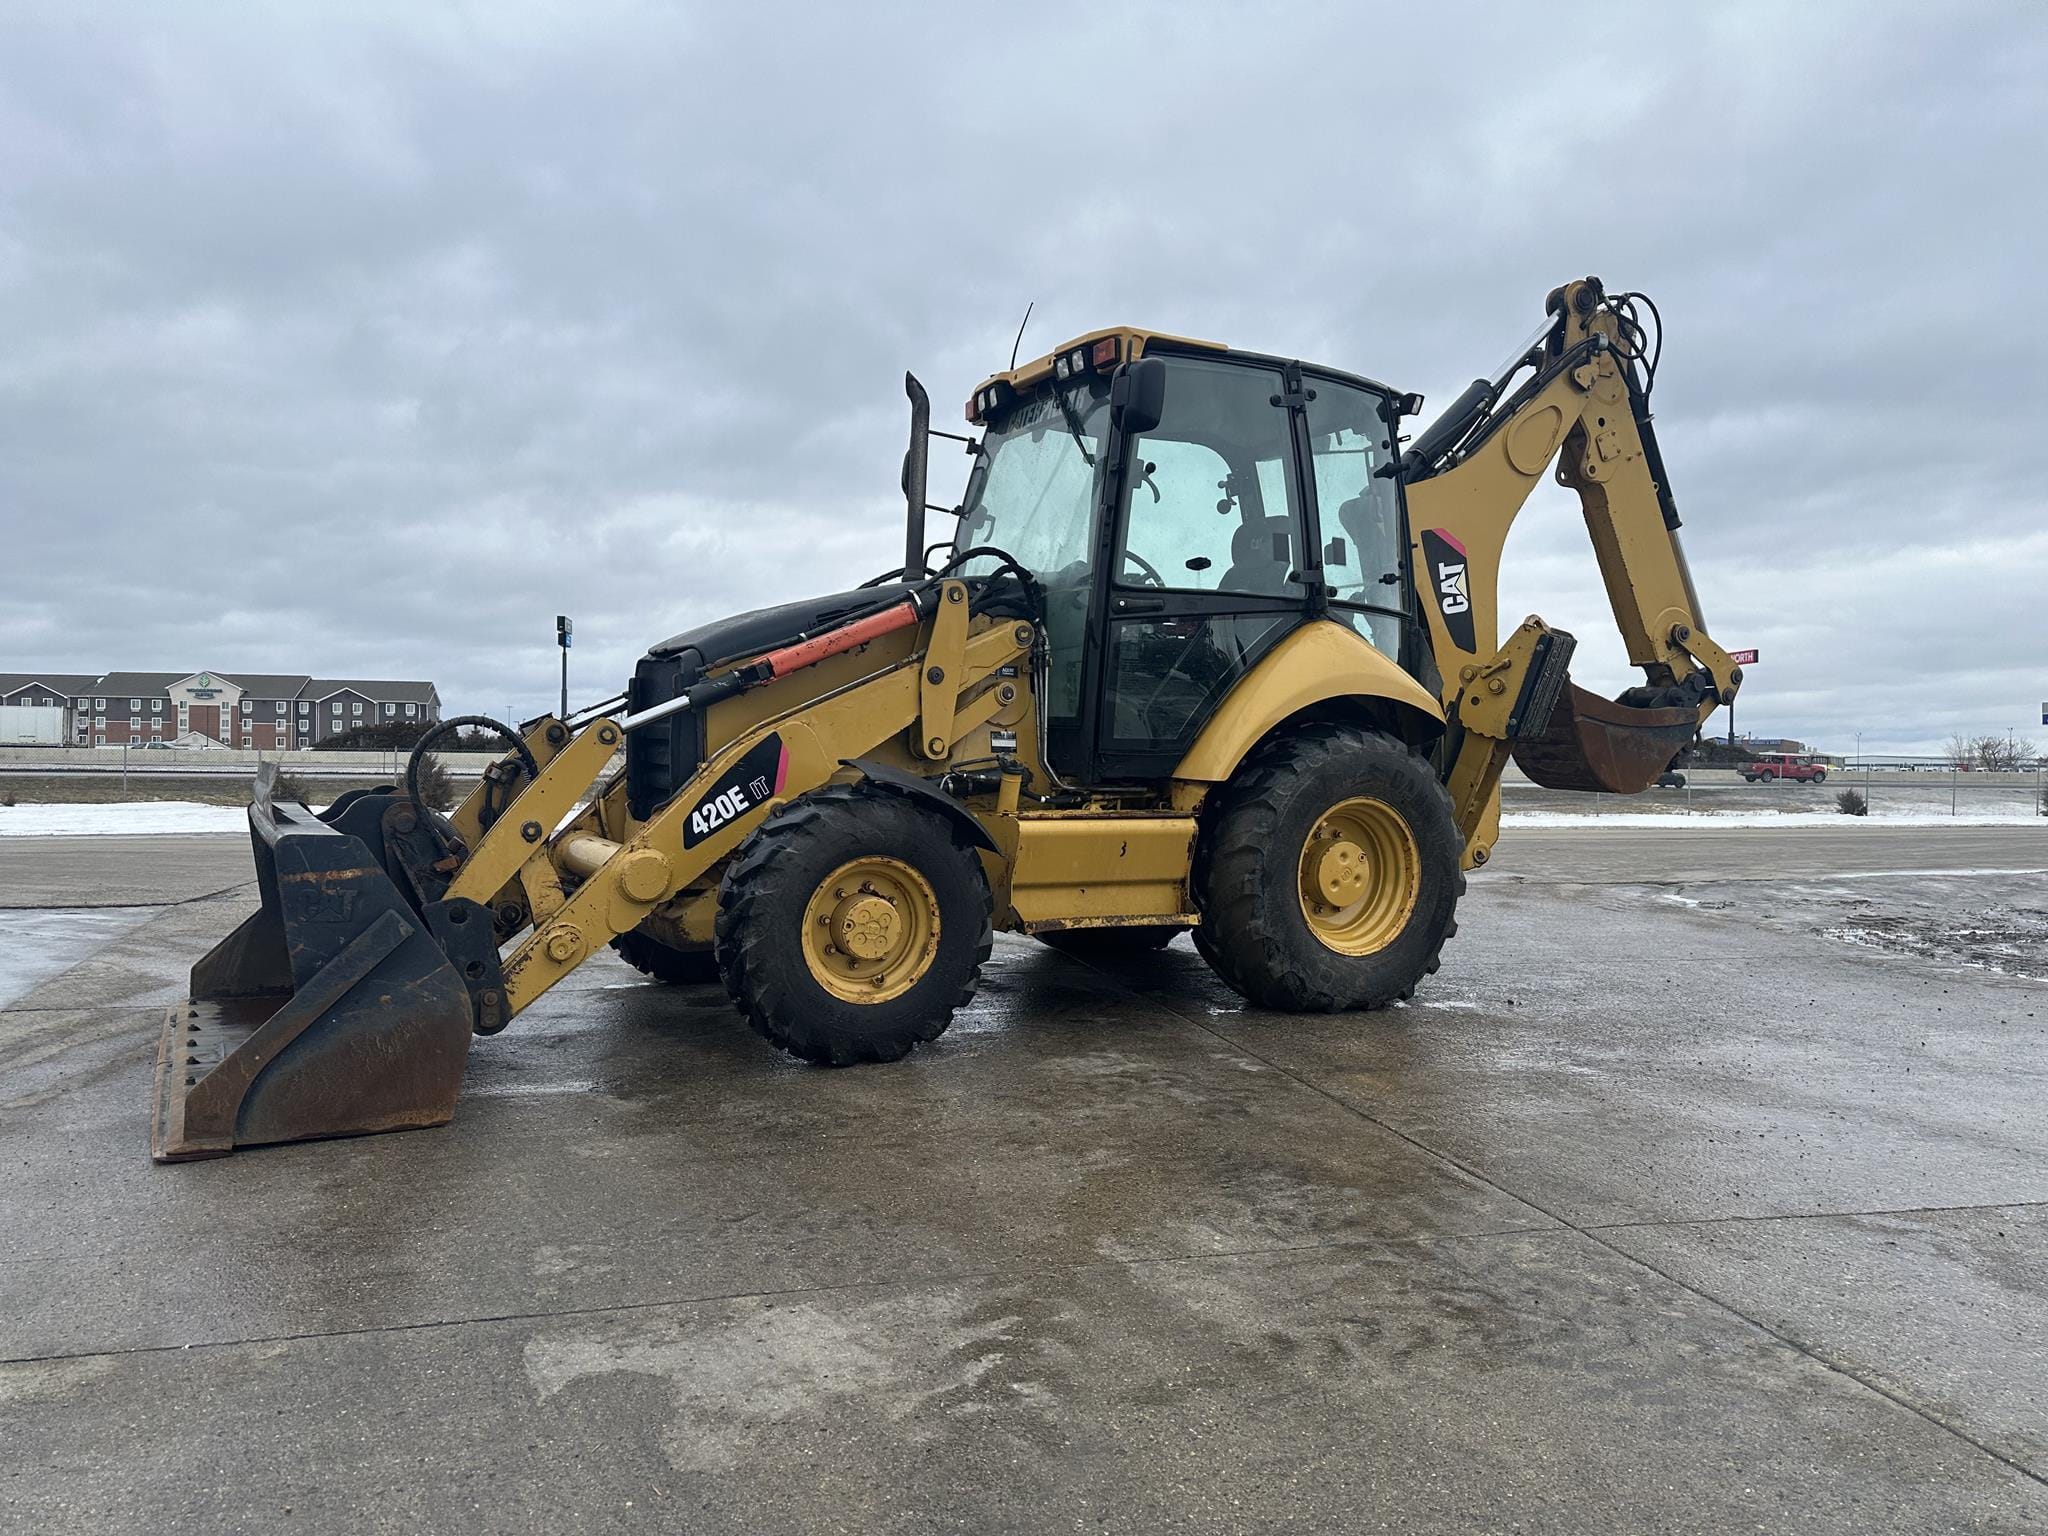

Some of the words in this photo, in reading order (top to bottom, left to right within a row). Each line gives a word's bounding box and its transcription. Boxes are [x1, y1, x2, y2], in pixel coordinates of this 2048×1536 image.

[1438, 562, 1469, 615] CAT
[692, 785, 750, 834] 420E
[749, 775, 770, 800] IT
